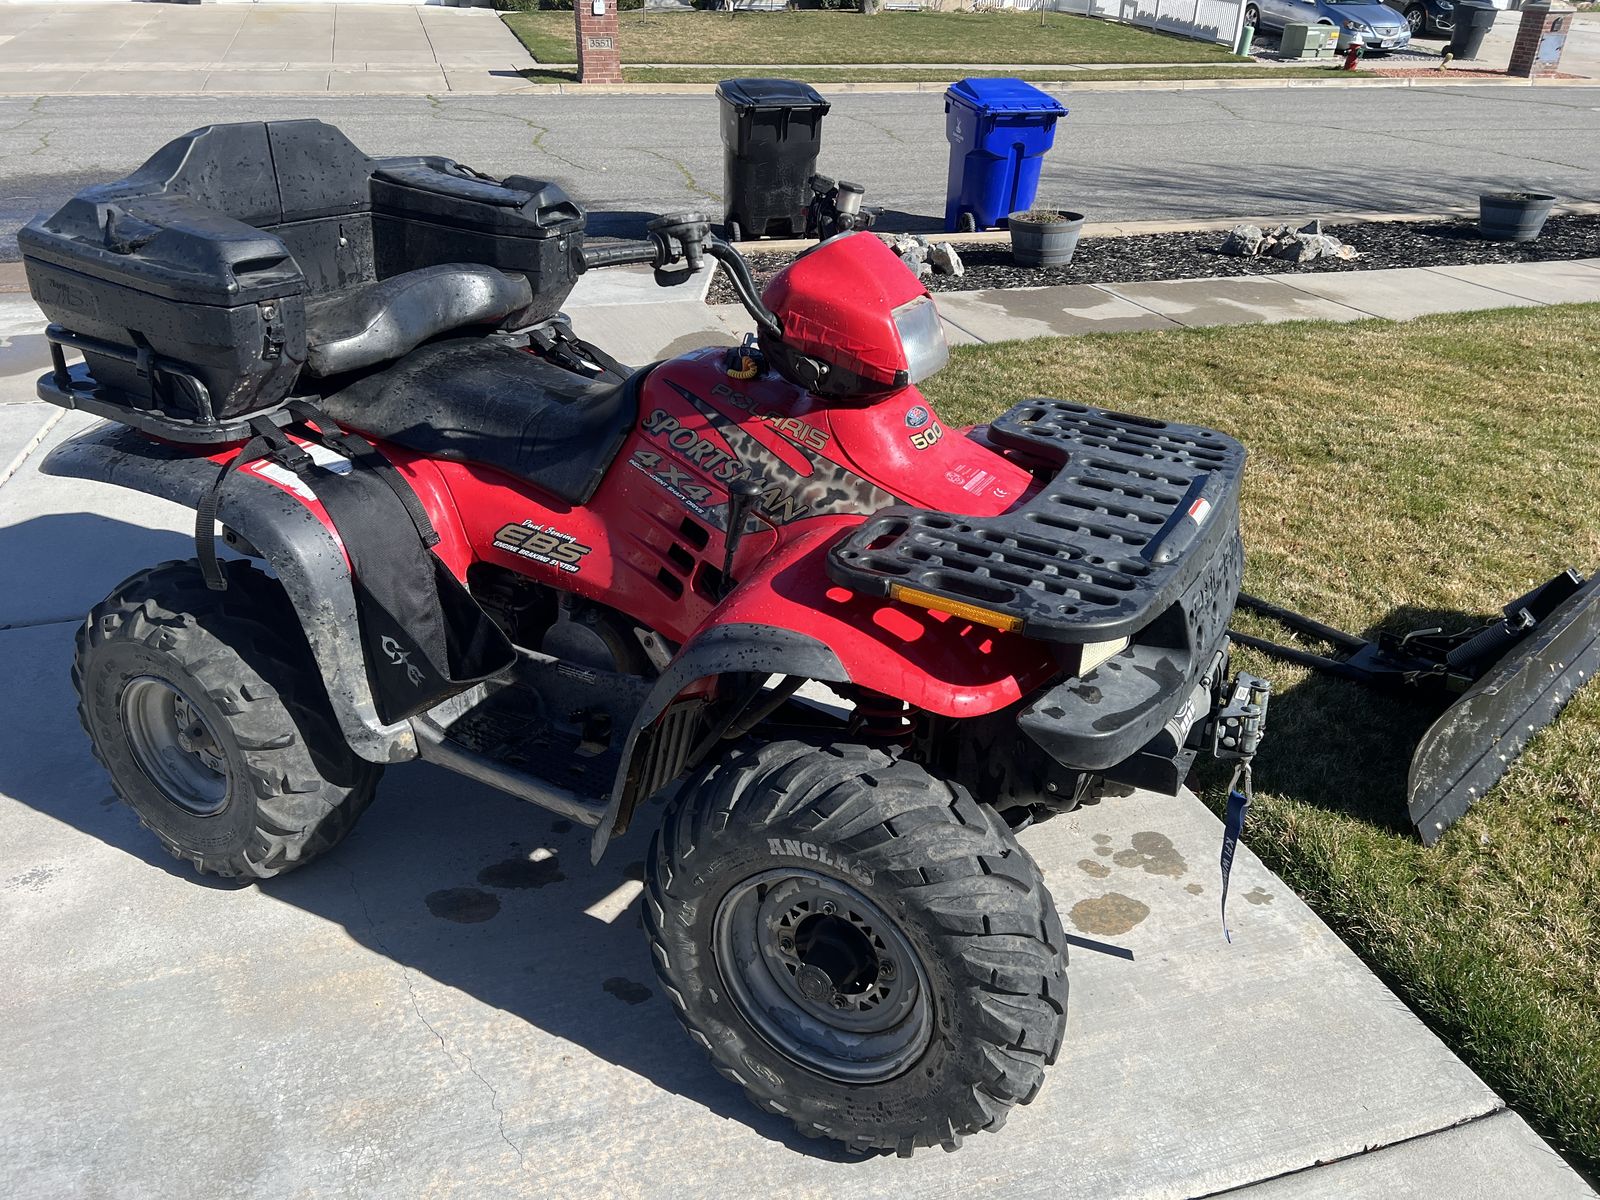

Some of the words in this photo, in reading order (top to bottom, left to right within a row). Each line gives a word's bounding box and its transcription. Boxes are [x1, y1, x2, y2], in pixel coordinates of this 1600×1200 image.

[590, 39, 610, 48] 3551
[711, 383, 830, 451] POLARIS
[910, 421, 943, 450] 500
[666, 485, 687, 500] SHAFT
[685, 499, 705, 514] DRIVE
[495, 524, 591, 562] EBS
[522, 519, 545, 531] Dual
[544, 526, 577, 544] Sensing
[493, 540, 520, 553] ENGINE
[518, 547, 551, 563] BRAKING
[549, 559, 580, 573] SYSTEM
[1225, 836, 1235, 858] KFI
